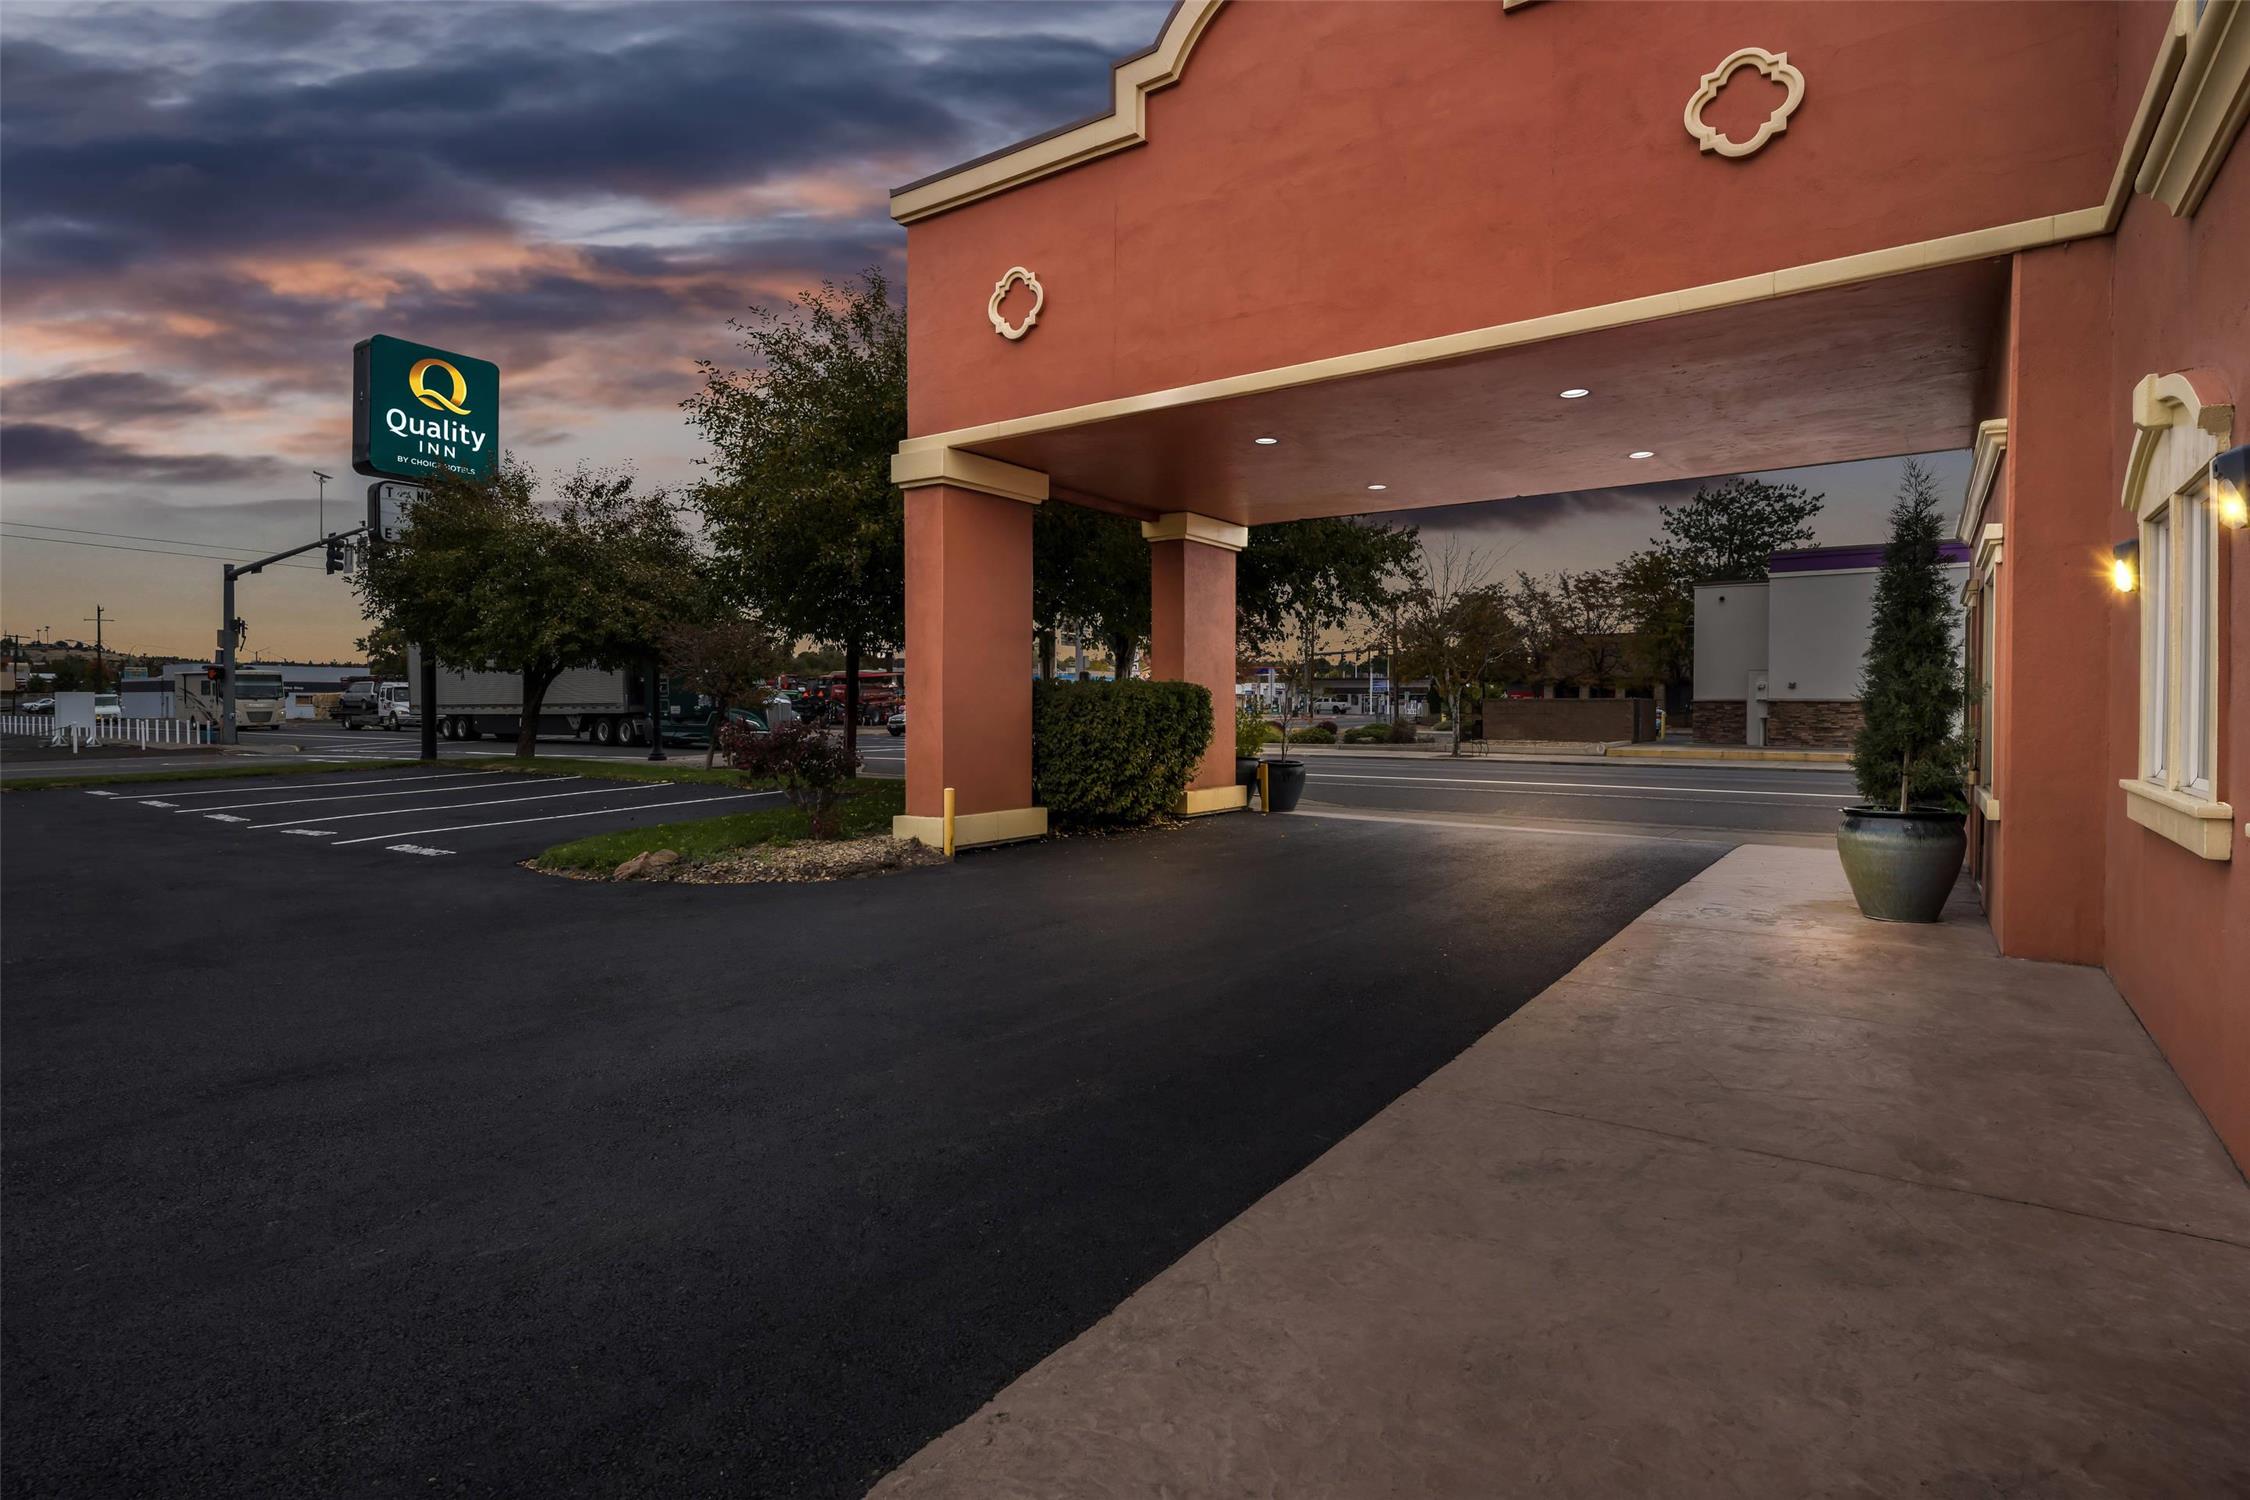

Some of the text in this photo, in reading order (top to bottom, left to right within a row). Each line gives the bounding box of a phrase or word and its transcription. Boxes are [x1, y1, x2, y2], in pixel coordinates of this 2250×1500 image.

[409, 358, 472, 416] Q
[386, 408, 486, 452] Quality
[397, 455, 409, 463] BY
[410, 458, 441, 469] CHOIC
[419, 440, 456, 459] INN
